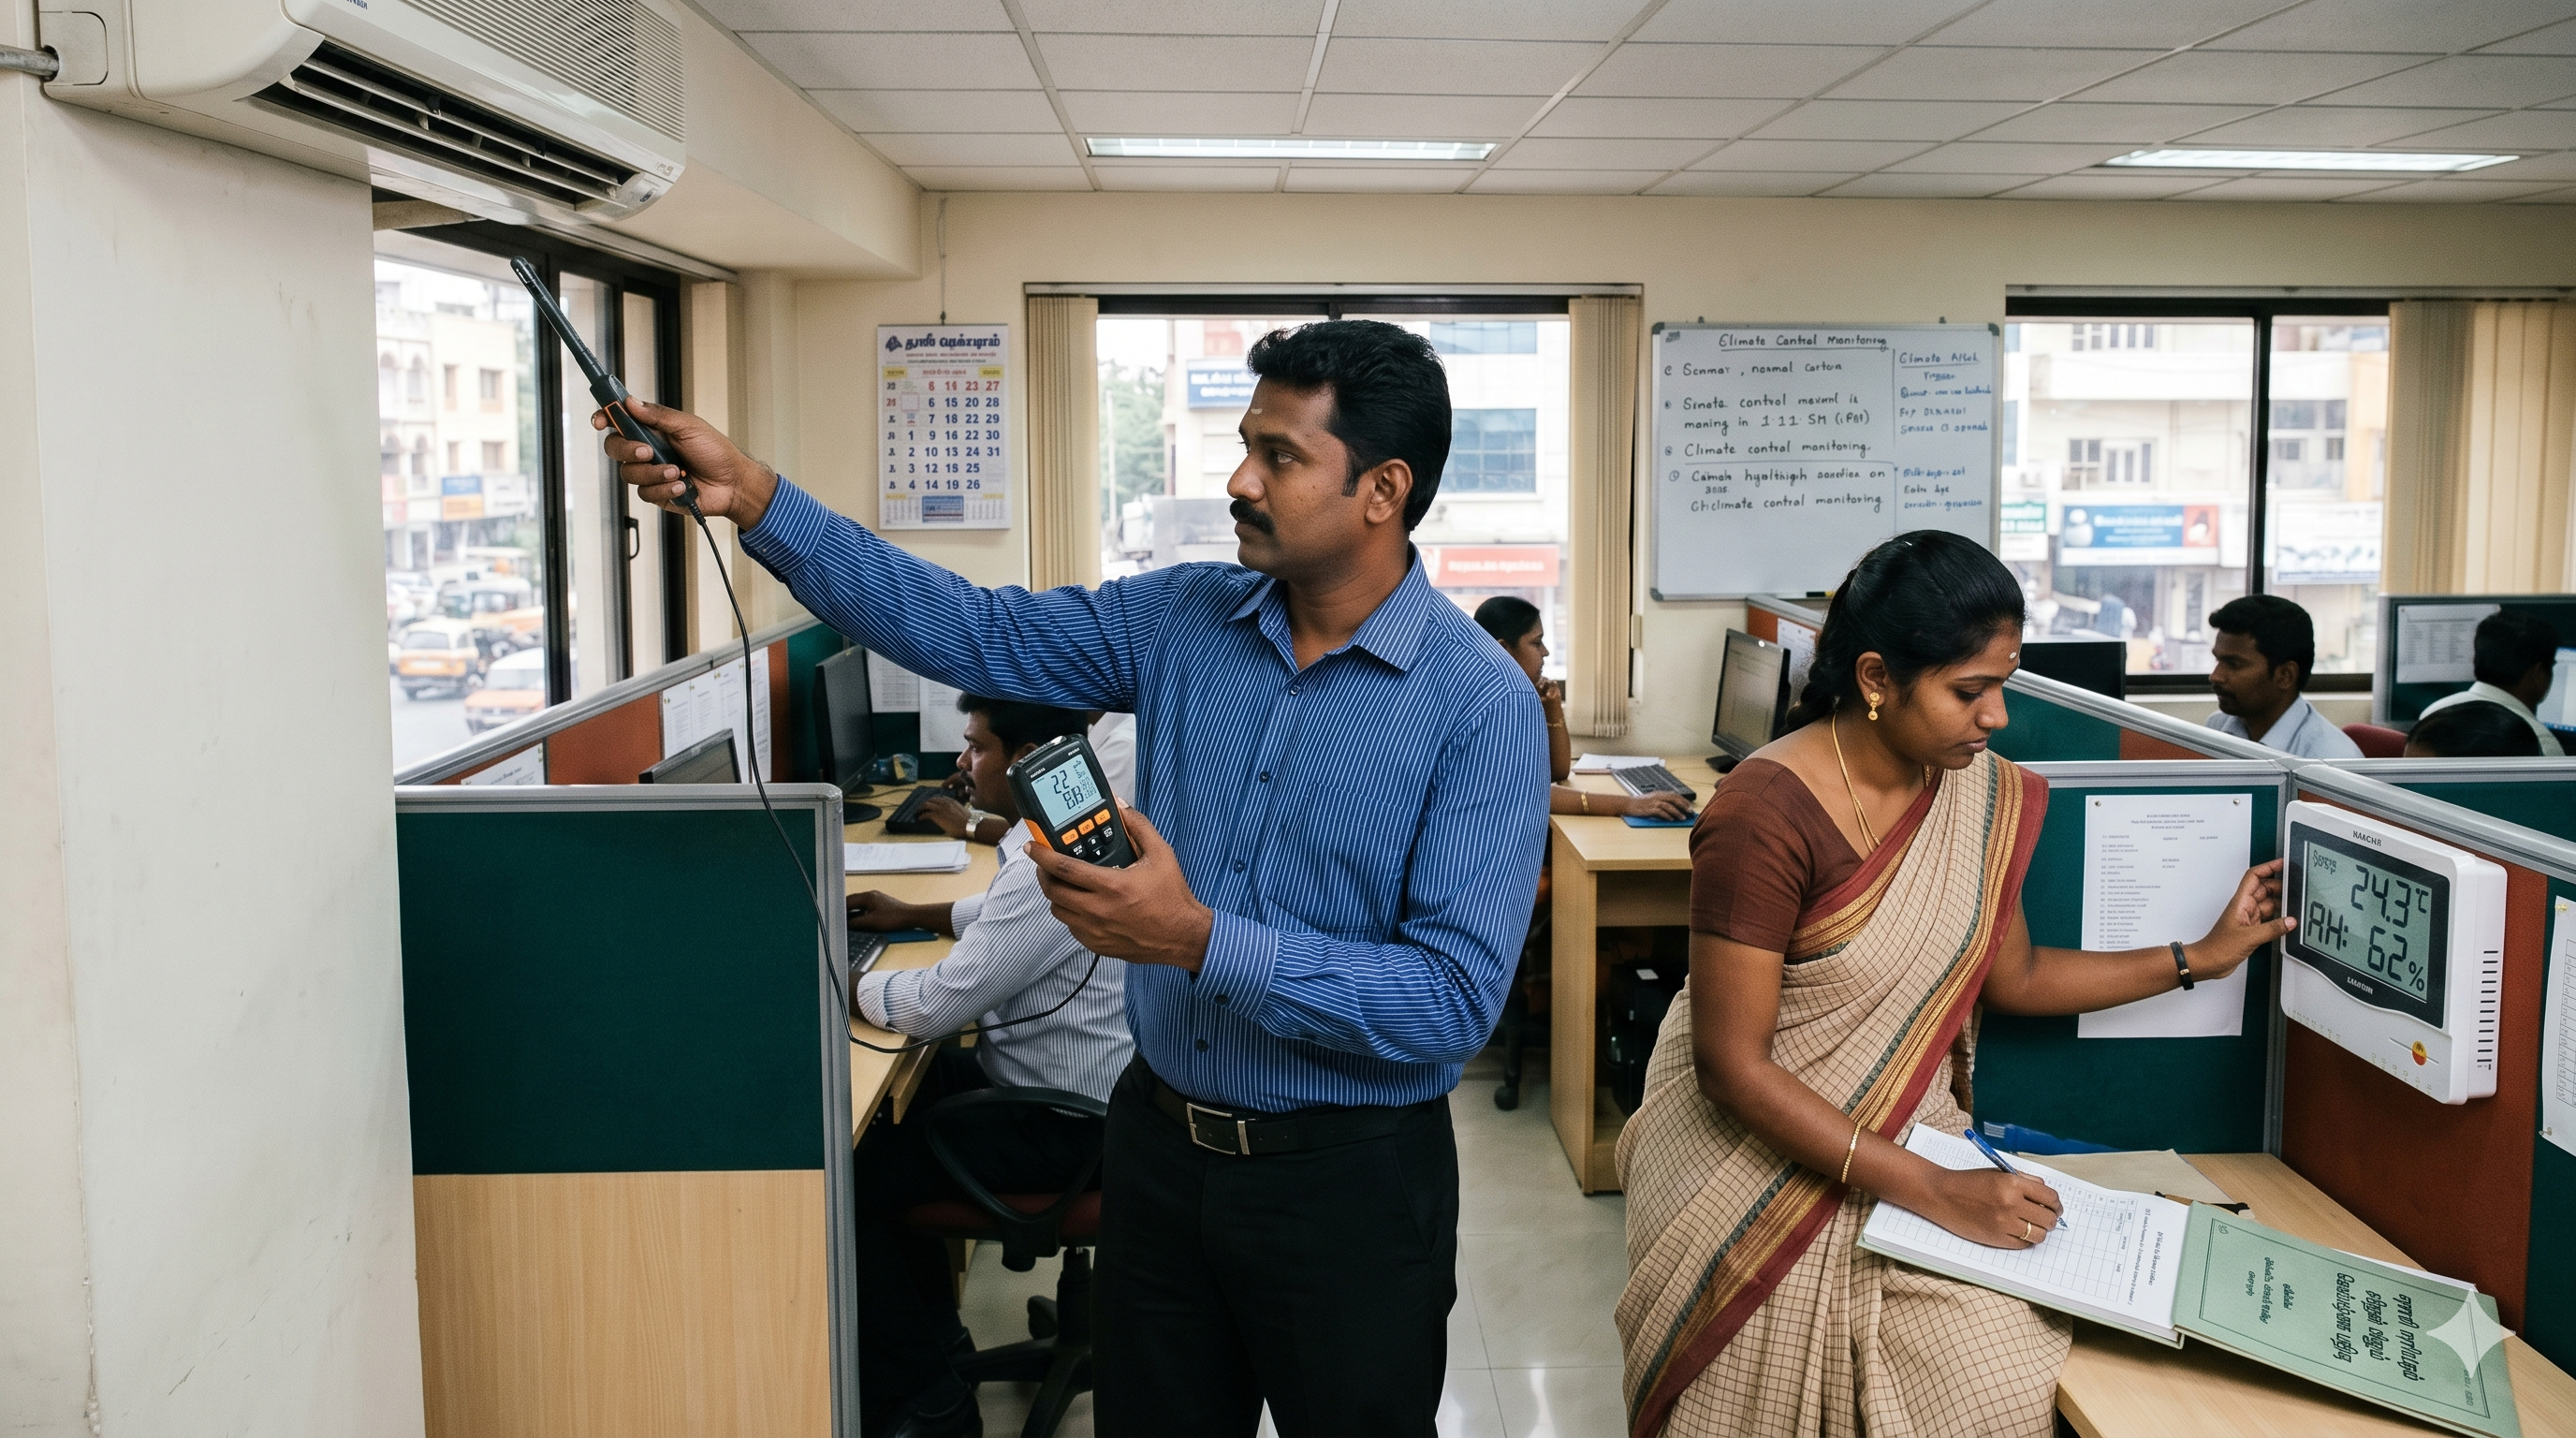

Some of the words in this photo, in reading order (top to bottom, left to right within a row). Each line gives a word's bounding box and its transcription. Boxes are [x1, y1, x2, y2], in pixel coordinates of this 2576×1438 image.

[966, 381, 978, 391] 23
[986, 381, 1000, 391] 27
[929, 398, 935, 407] 6
[965, 397, 979, 407] 20
[986, 397, 999, 407] 28
[929, 414, 935, 423] 7
[966, 414, 978, 423] 22
[986, 414, 1000, 424] 29
[1738, 417, 1749, 426] in
[909, 431, 914, 440] 1
[929, 431, 936, 440] 9
[965, 430, 978, 440] 22
[987, 430, 1000, 440] 30
[909, 448, 915, 457] 2
[925, 447, 938, 457] 10
[966, 447, 979, 456] 24
[988, 447, 1000, 457] 31
[1685, 443, 1736, 457] Climate
[909, 463, 915, 473] 3
[926, 463, 938, 473] 12
[966, 463, 980, 473] 25
[909, 480, 915, 490] 4
[926, 480, 938, 490] 14
[967, 479, 980, 490] 26
